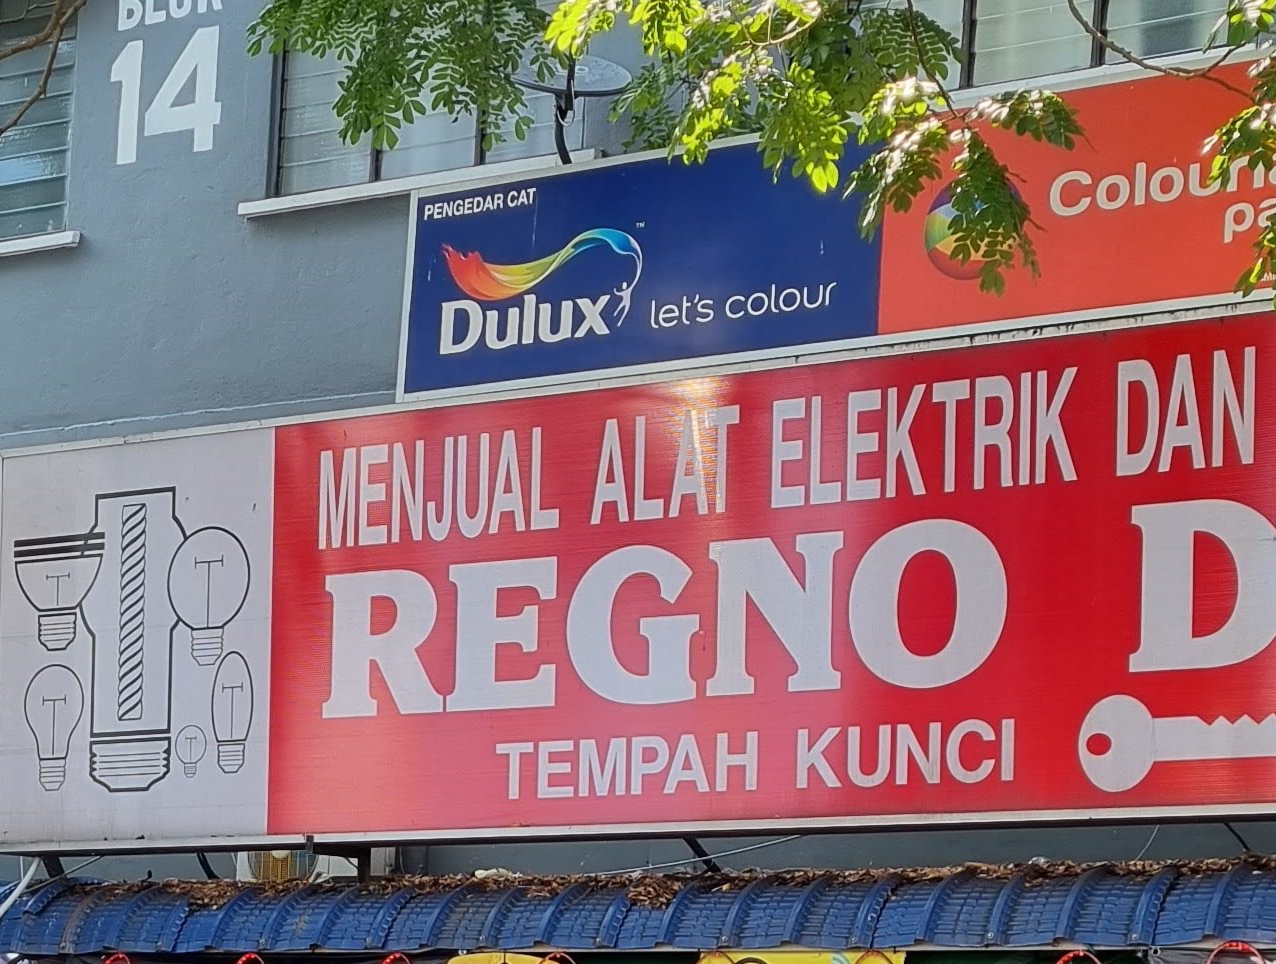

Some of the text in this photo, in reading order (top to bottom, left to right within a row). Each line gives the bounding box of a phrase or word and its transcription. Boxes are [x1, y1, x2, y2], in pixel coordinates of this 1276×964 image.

[118, 0, 223, 31] BL
[110, 25, 222, 165] 14
[423, 188, 537, 220] PENGEDAR CAT
[439, 293, 611, 355] Dulux
[649, 280, 837, 329] let's colour
[318, 426, 560, 550] MENJUAL
[590, 404, 740, 524] ALAT
[771, 366, 1078, 508] ELEKTRIK
[1116, 346, 1256, 477] DAN
[323, 518, 1008, 719] REGNO
[496, 718, 1015, 799] TEMPAH KUNCI
